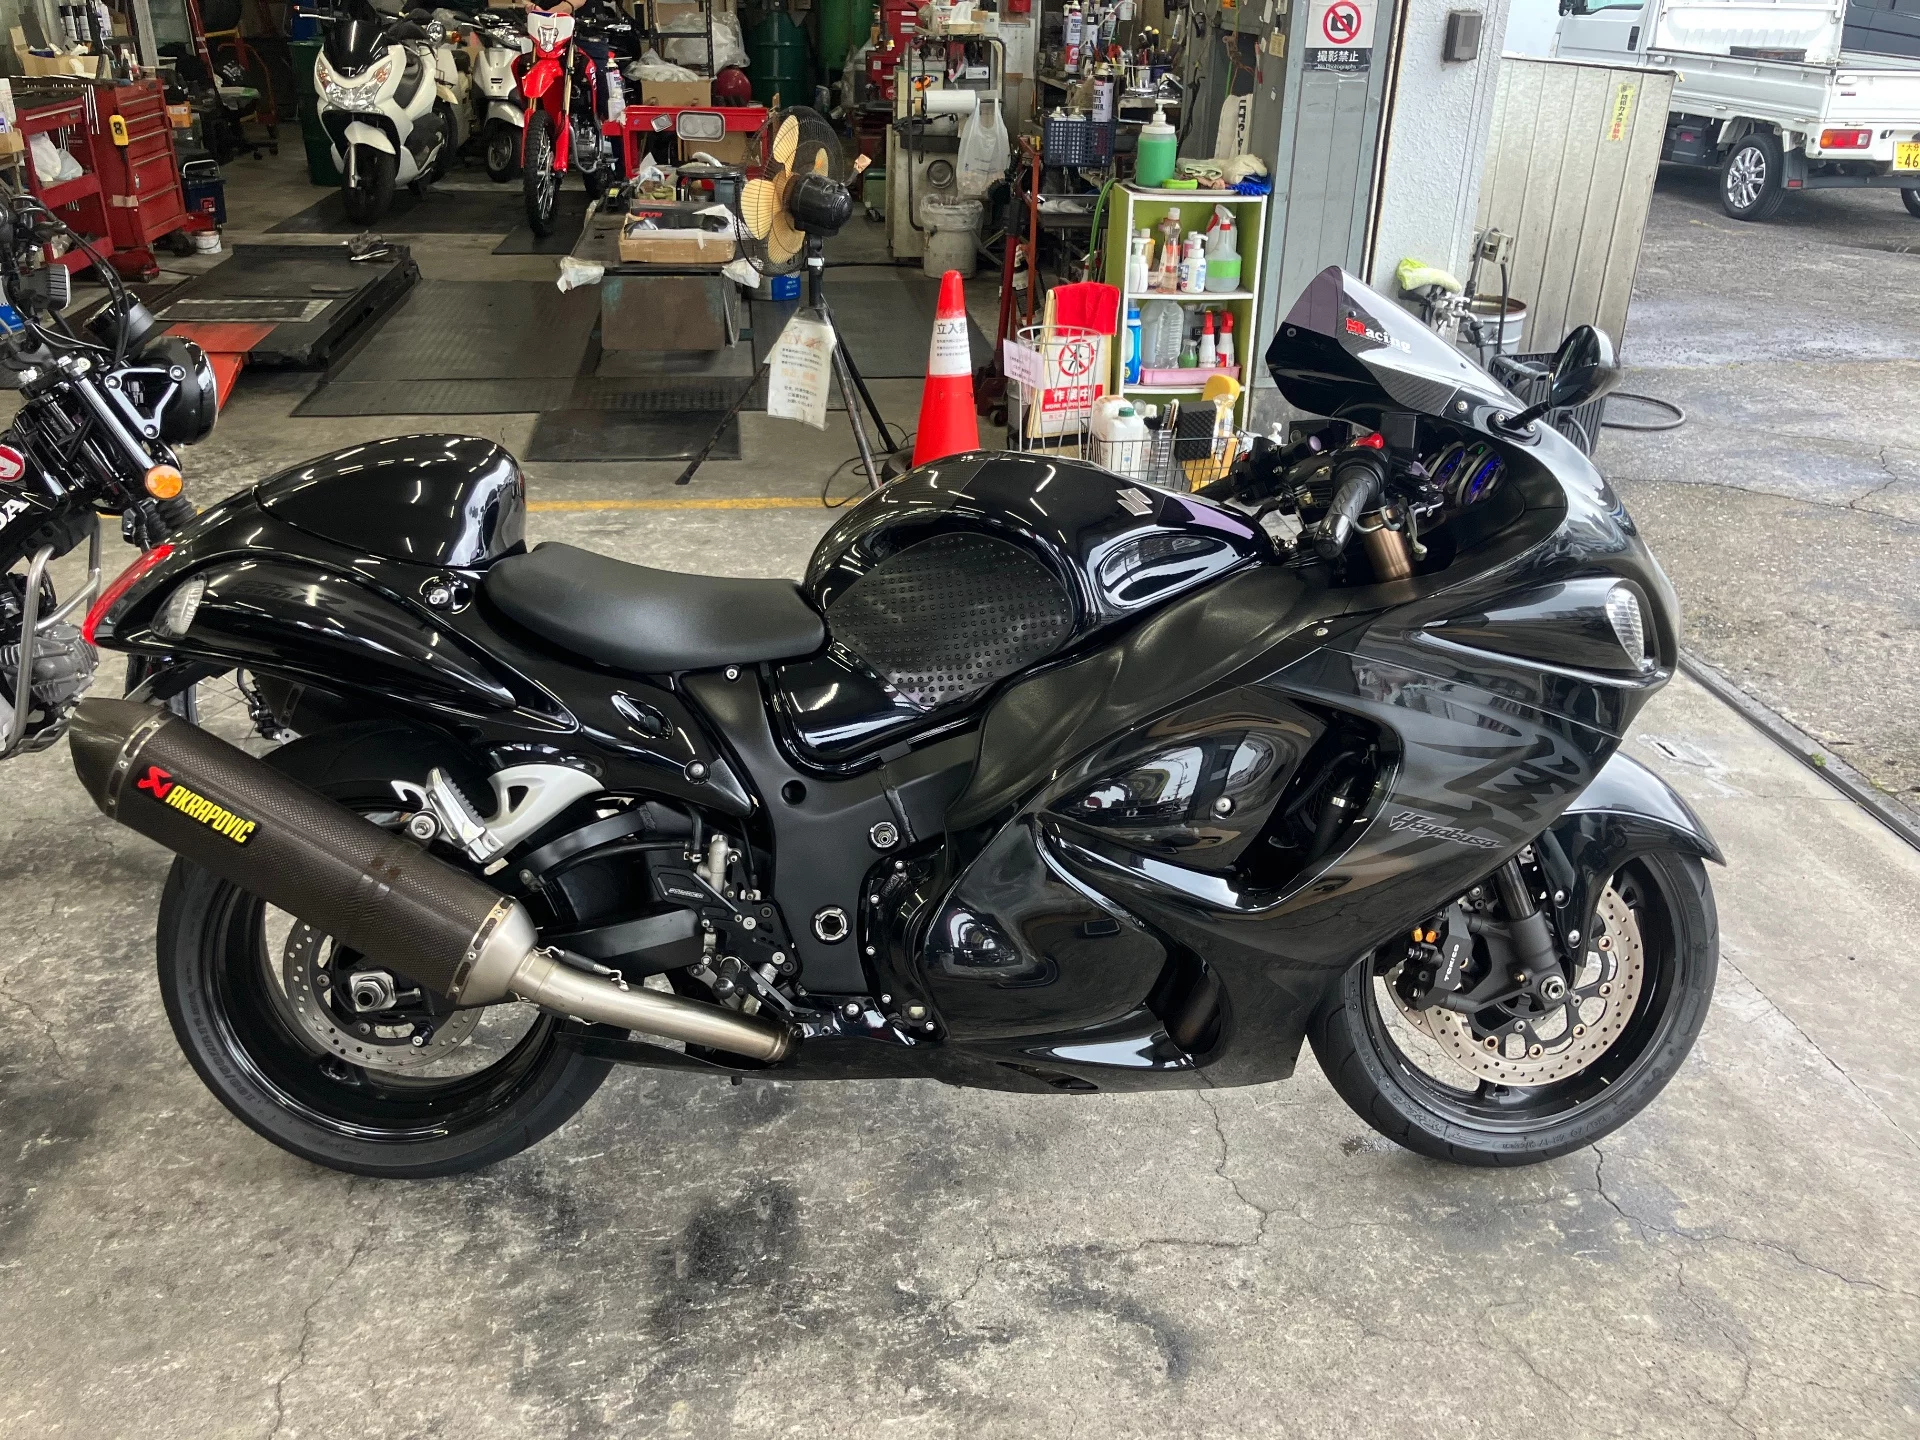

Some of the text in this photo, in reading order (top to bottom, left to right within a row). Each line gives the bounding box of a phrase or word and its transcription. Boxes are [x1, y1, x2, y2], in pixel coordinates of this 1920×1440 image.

[1317, 50, 1359, 62] 撮影禁止
[1054, 388, 1091, 402] 作業中
[1389, 811, 1505, 849] Hayabusa
[1444, 944, 1460, 982] TOKICO
